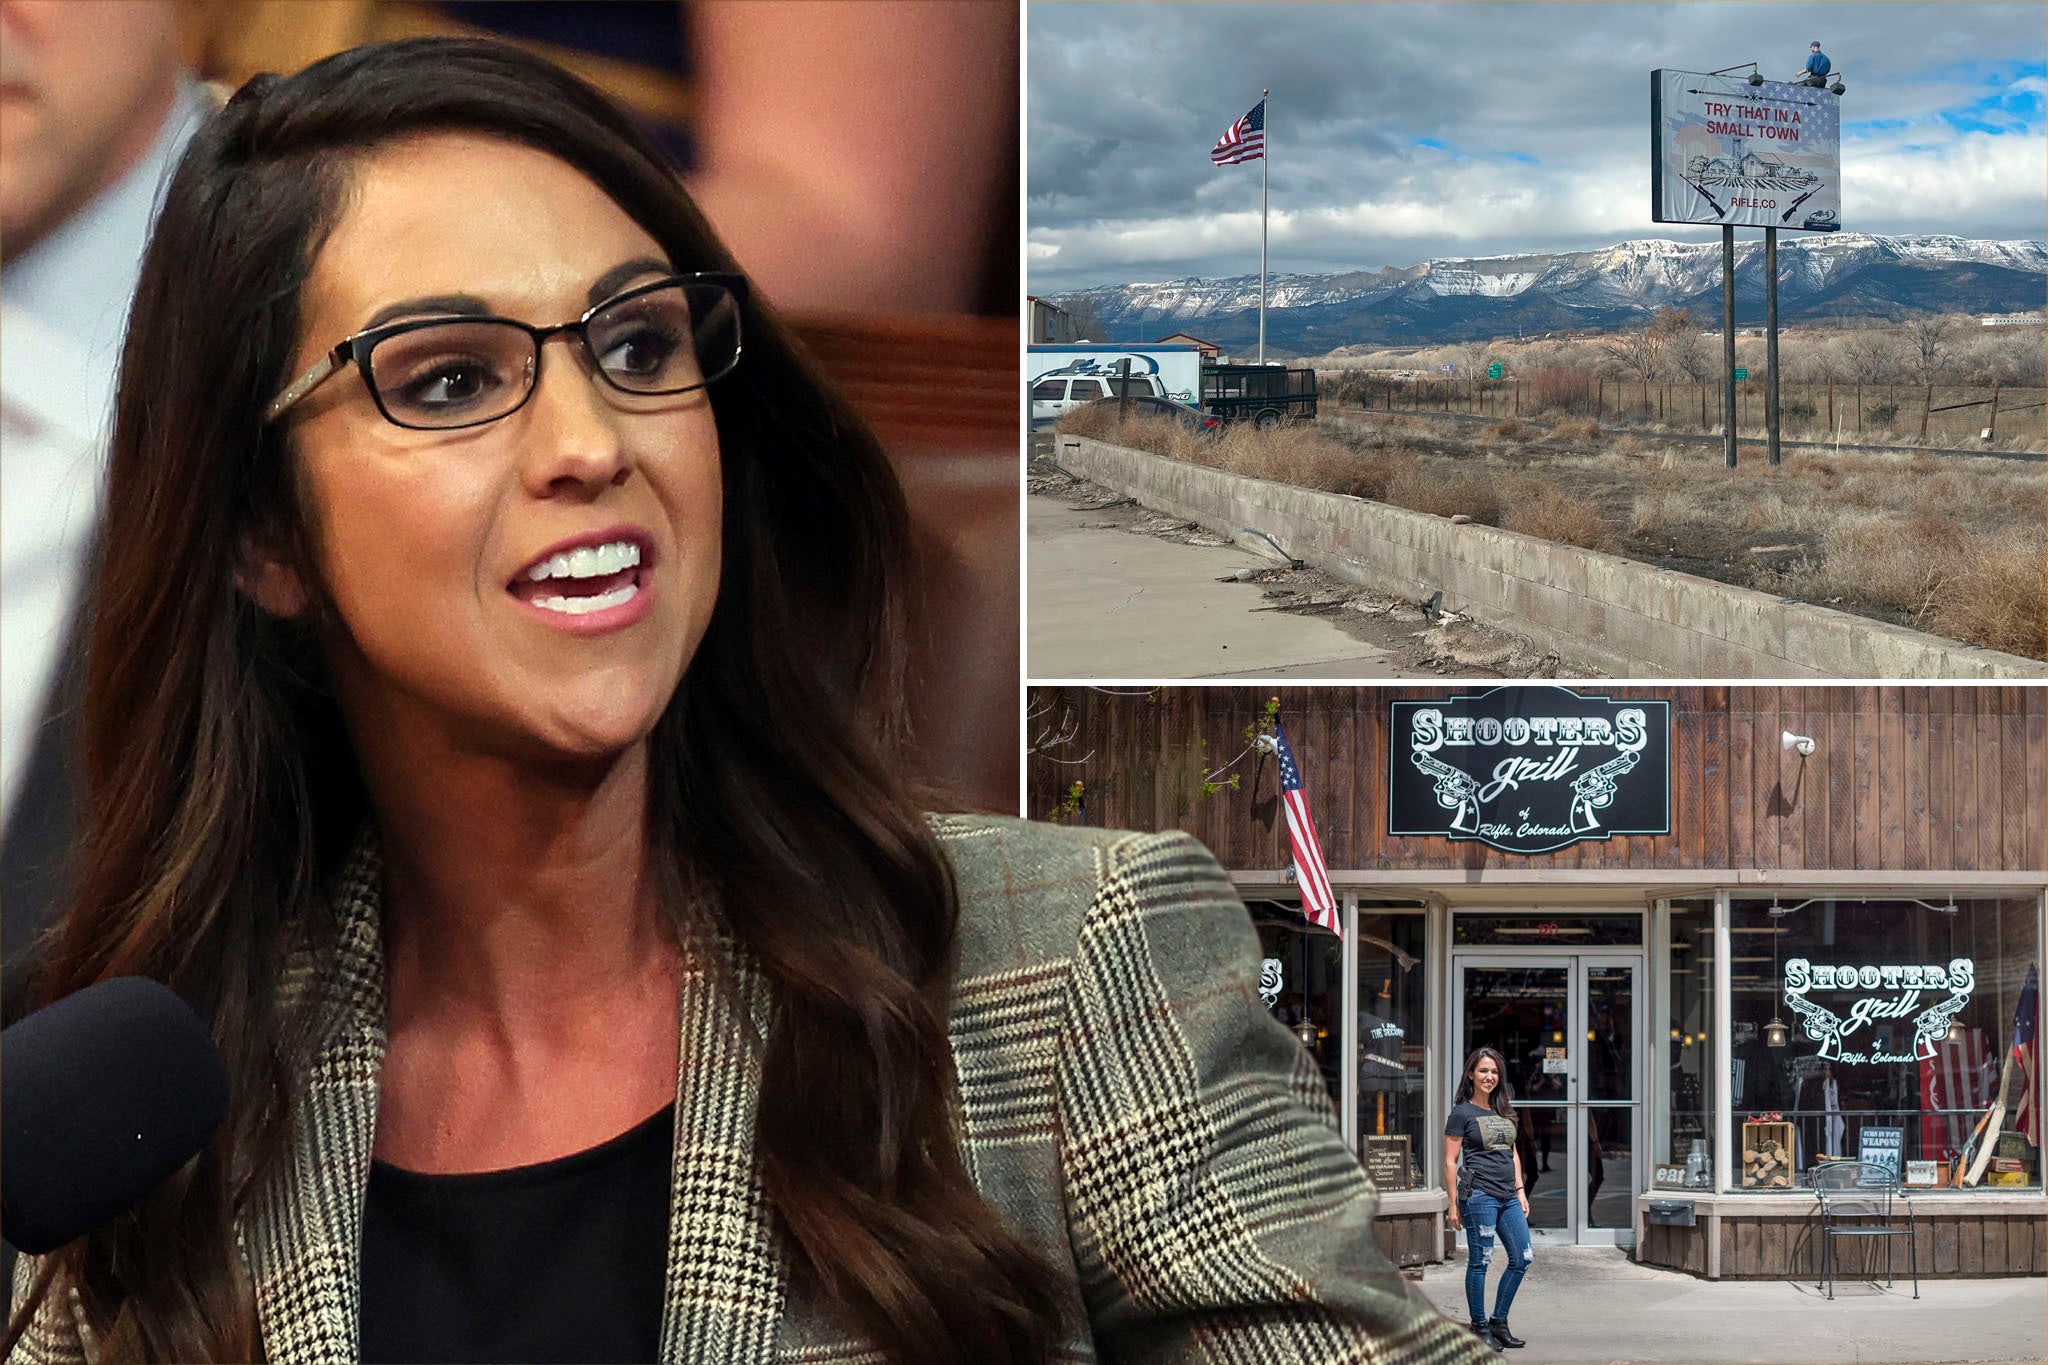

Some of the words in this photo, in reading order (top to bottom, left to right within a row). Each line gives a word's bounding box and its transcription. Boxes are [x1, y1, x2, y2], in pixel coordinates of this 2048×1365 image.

[1704, 102, 1732, 118] TRY
[1736, 105, 1770, 120] THAT
[1775, 108, 1788, 122] IN
[1792, 111, 1801, 124] A
[1706, 121, 1754, 137] SMALL
[1758, 125, 1799, 141] TOWN
[1411, 708, 1648, 752] SHOOTERS
[1478, 746, 1580, 804] grill
[1518, 807, 1531, 820] of
[1478, 823, 1513, 840] Rifle,
[1516, 822, 1571, 838] Colorado
[1784, 958, 1975, 995] SHOOTERS
[1839, 989, 1921, 1037] grill
[1871, 1038, 1883, 1051] of
[1871, 1051, 1915, 1064] Colorado
[1862, 1137, 1900, 1147] WEAPONS
[1656, 1167, 1685, 1183] eat
